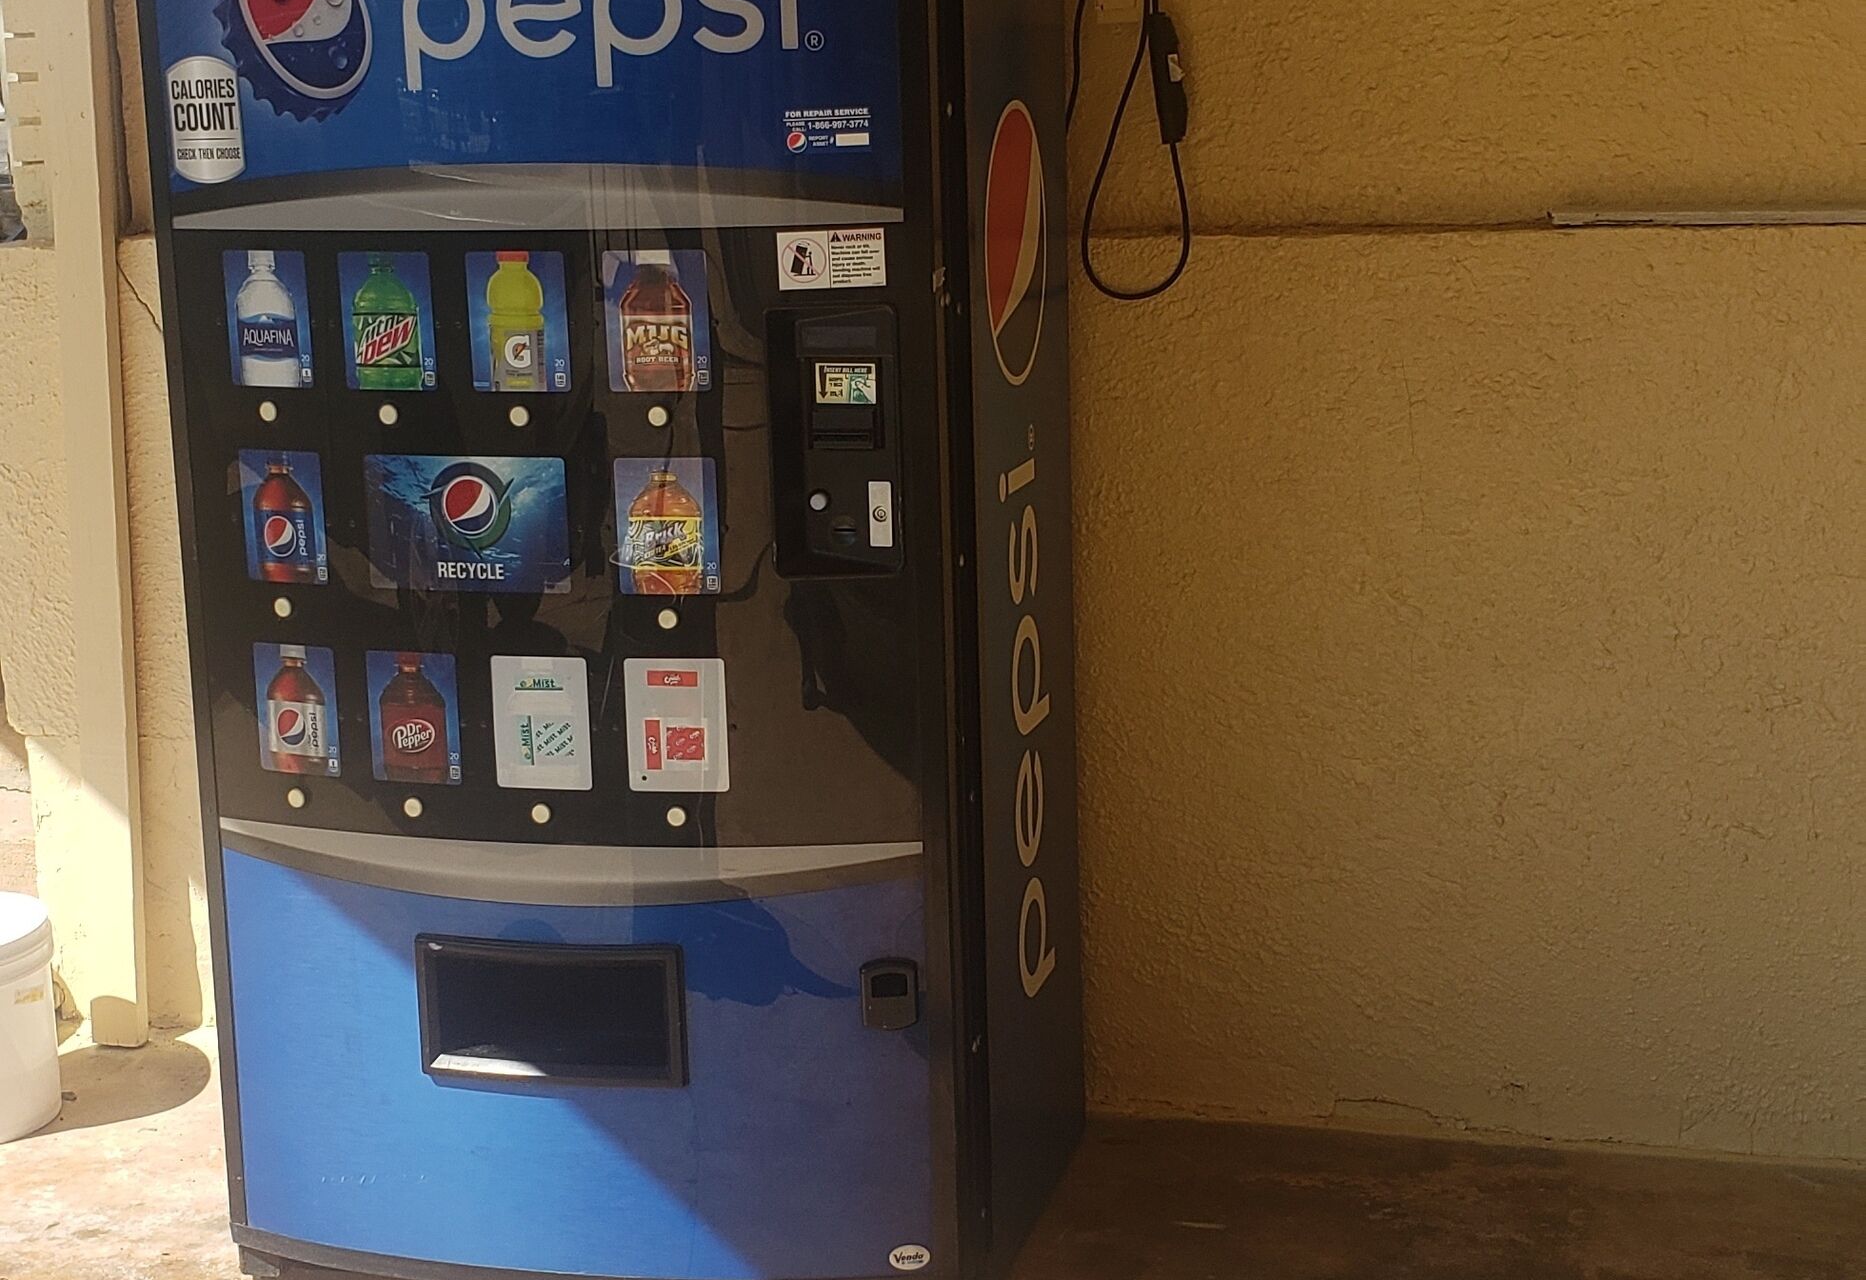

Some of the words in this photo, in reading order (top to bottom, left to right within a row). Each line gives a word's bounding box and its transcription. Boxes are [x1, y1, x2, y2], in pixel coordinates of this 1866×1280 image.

[171, 78, 235, 100] CALORIES
[173, 102, 237, 132] COUNT
[803, 109, 832, 117] REPAIR
[834, 108, 869, 116] SERVICE
[177, 148, 197, 160] CHECK
[198, 147, 215, 160] THEN
[216, 147, 241, 160] CHOOSE
[842, 232, 882, 242] WARNING
[243, 328, 294, 347] AQUAFINA
[626, 325, 689, 351] MUG
[504, 335, 532, 368] G
[636, 356, 657, 364] ROOT
[296, 519, 308, 556] pepsi
[437, 561, 505, 580] RECYCLE
[393, 726, 432, 749] Pepper
[406, 723, 422, 736] Dr
[999, 458, 1056, 998] pepsi
